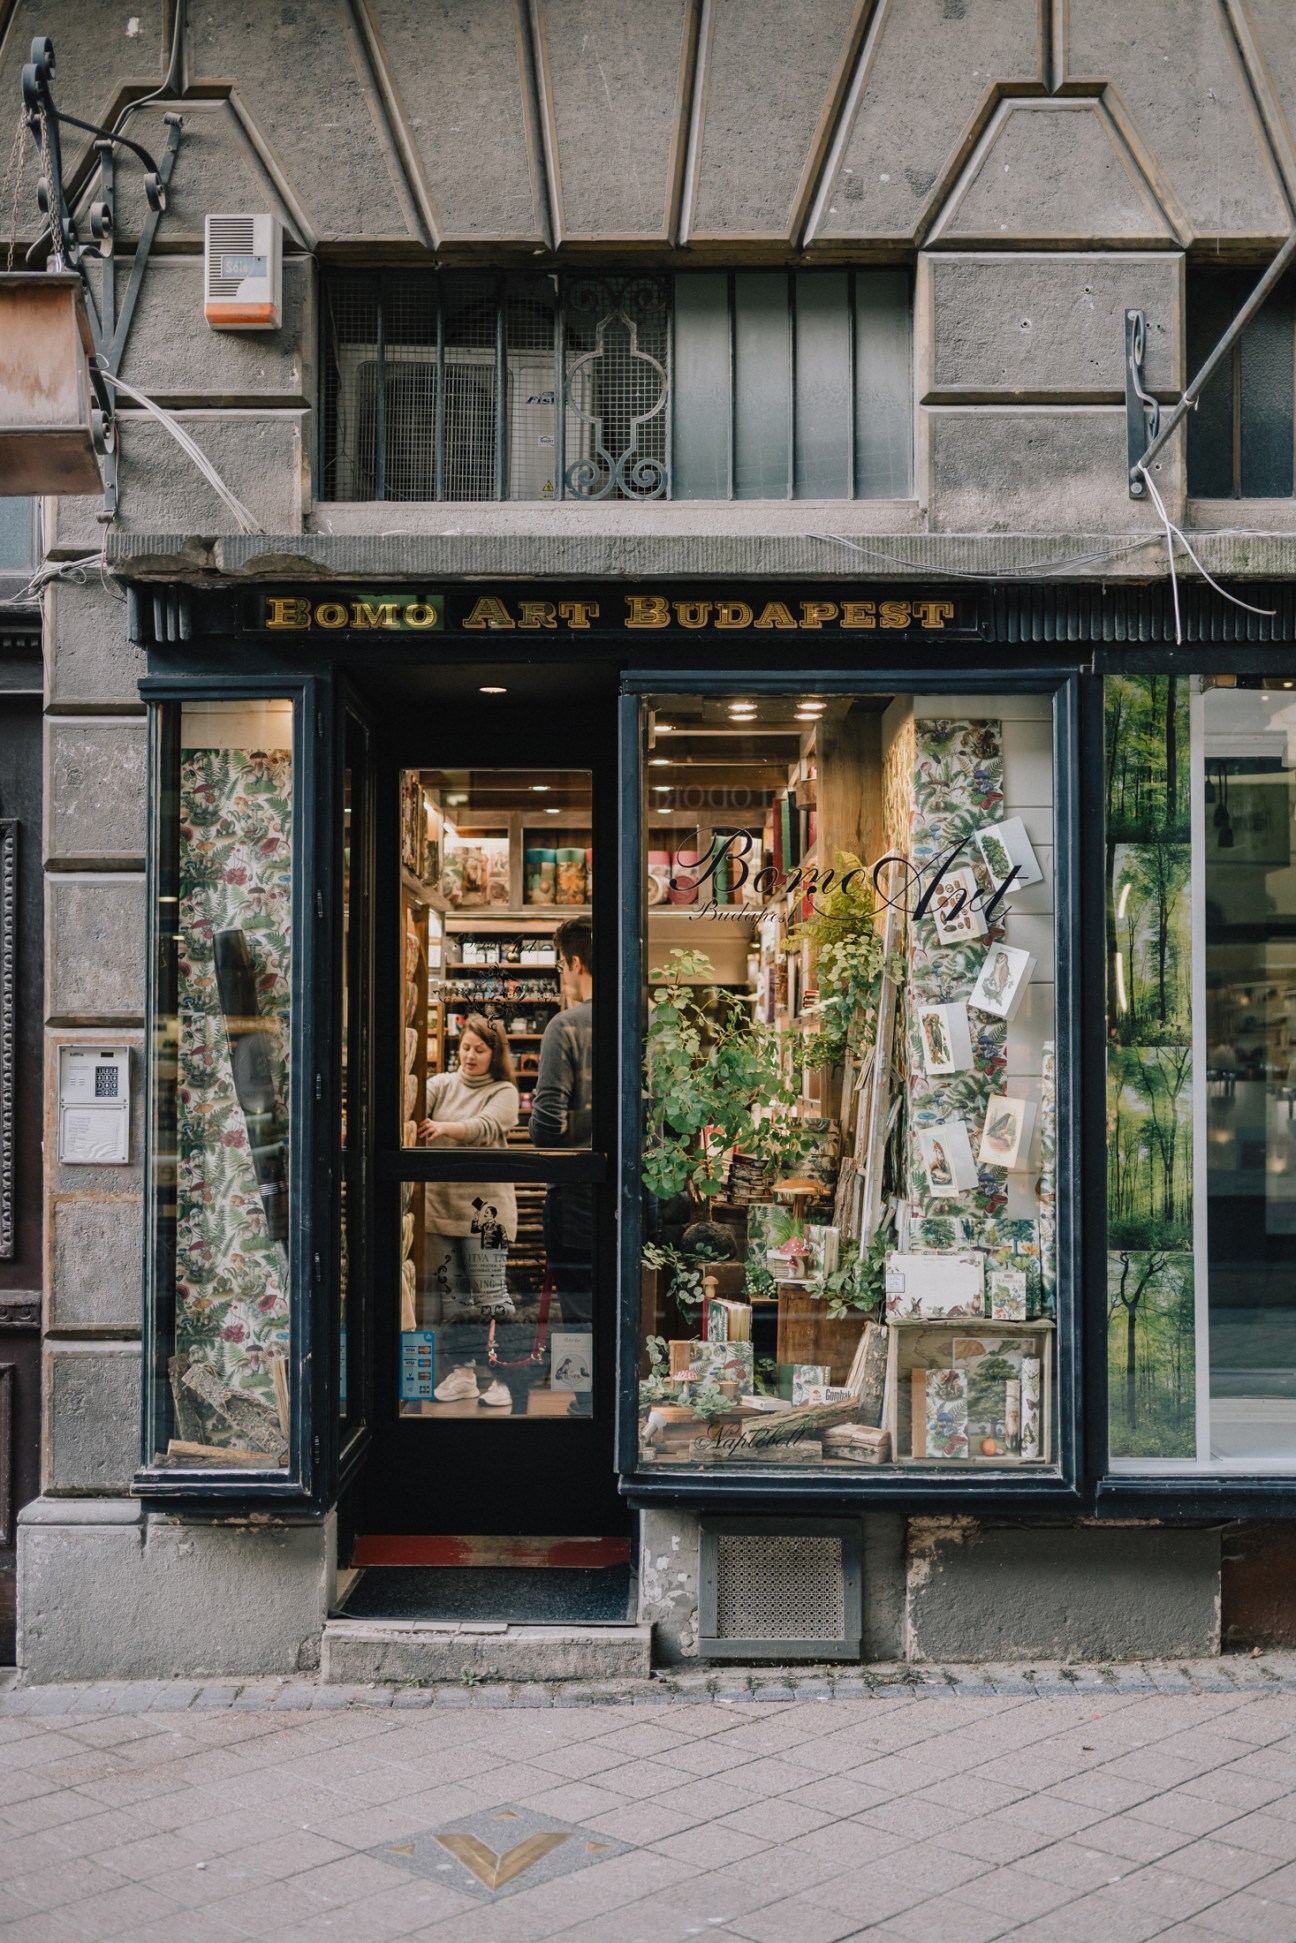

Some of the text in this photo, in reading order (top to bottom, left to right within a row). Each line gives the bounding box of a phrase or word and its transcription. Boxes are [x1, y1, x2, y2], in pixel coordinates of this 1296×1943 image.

[670, 825, 1029, 923] Bomo Art
[689, 896, 797, 931] Budapest
